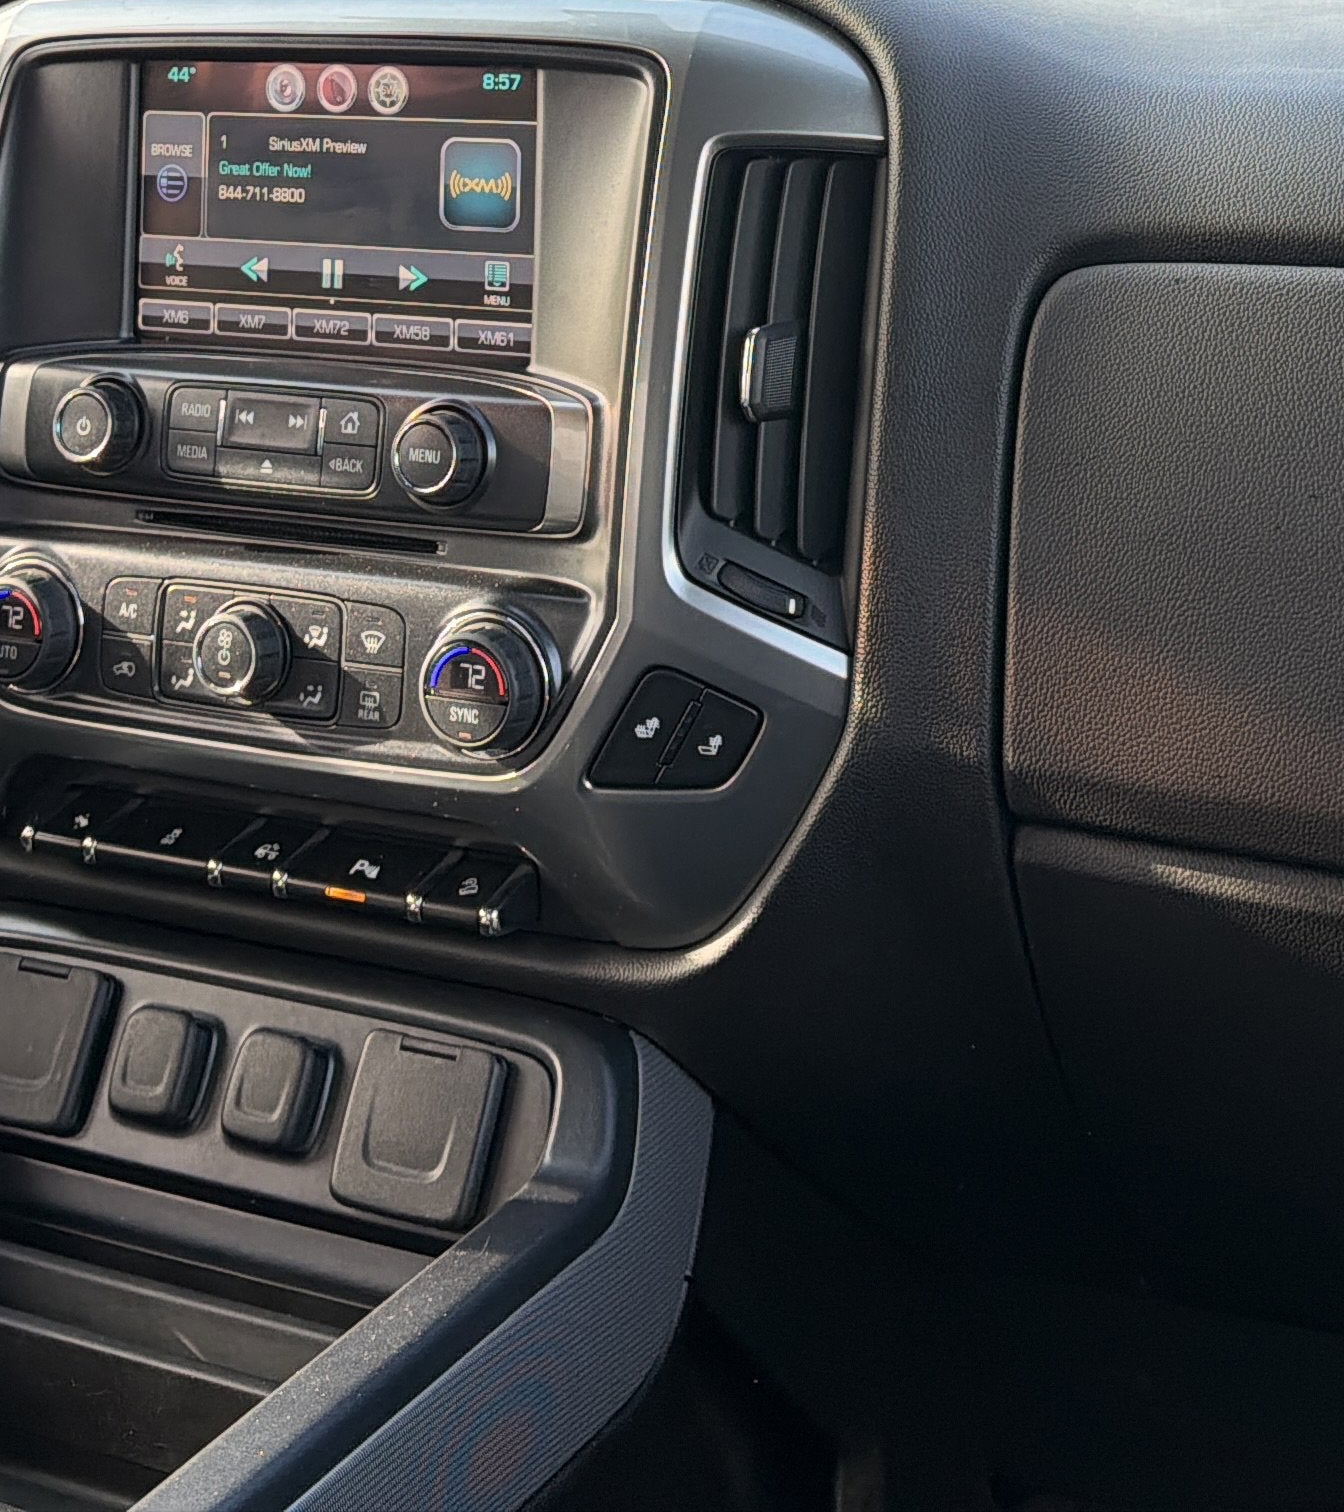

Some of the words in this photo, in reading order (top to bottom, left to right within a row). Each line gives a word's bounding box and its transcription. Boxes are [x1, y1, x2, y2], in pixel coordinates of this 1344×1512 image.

[482, 72, 522, 91] 8:57
[150, 142, 194, 158] BROWSE
[220, 134, 228, 150] 1
[268, 135, 321, 153] SiriusXM
[322, 137, 368, 155] Preview
[218, 160, 251, 176] Great
[252, 161, 281, 178] Offer
[283, 162, 313, 179] Now!
[218, 184, 307, 204] 844-711-8800
[165, 275, 189, 287] VOICE
[483, 294, 511, 307] MENU
[162, 309, 189, 325] XM6
[238, 314, 267, 329] XM7
[313, 319, 351, 336] XM72
[393, 324, 431, 342] XM58
[478, 330, 515, 348] XM61
[181, 401, 212, 418] RADIO
[176, 443, 208, 460] MEDIA
[408, 446, 442, 466] MENU
[335, 458, 365, 475] BACK
[1, 604, 25, 631] 72
[118, 601, 139, 620] A/C
[459, 661, 487, 691] 72
[357, 708, 381, 723] REAR
[448, 705, 480, 726] SYNC
